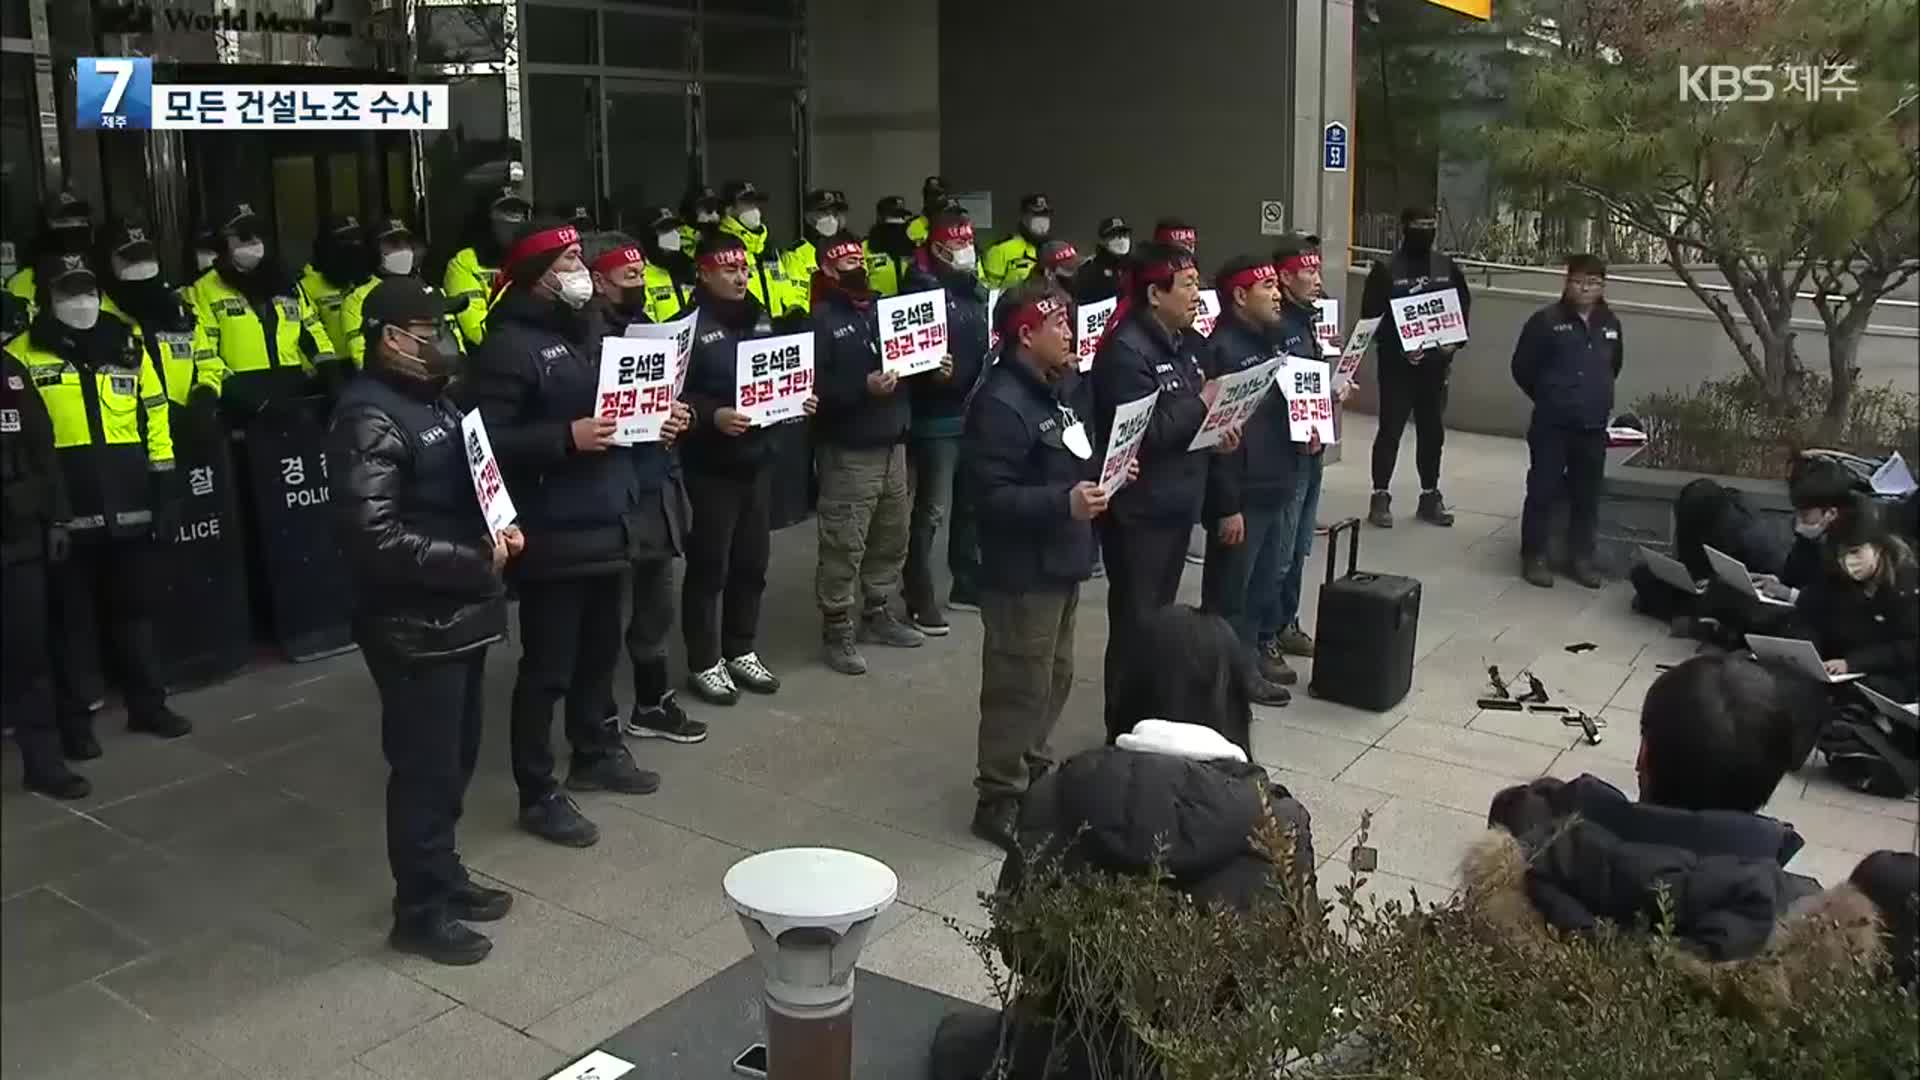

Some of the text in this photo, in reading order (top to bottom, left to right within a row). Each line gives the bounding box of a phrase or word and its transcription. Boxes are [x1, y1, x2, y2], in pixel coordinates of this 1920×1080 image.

[165, 9, 247, 31] World
[891, 301, 934, 332] 윤석열
[1403, 298, 1446, 321] 윤석열
[884, 322, 946, 360] 정권 규탄!
[1400, 320, 1425, 339] 정권
[618, 352, 665, 385] 윤석열
[752, 345, 800, 377] 윤석열
[740, 368, 813, 407] 정권 규탄!
[1294, 372, 1321, 394] 윤석열
[601, 384, 673, 419] 정권 규탄!
[1290, 398, 1308, 422] 정권
[1310, 397, 1331, 420] 규탄!
[189, 466, 214, 496] 찰
[280, 456, 305, 485] 경
[173, 519, 220, 543] LICE
